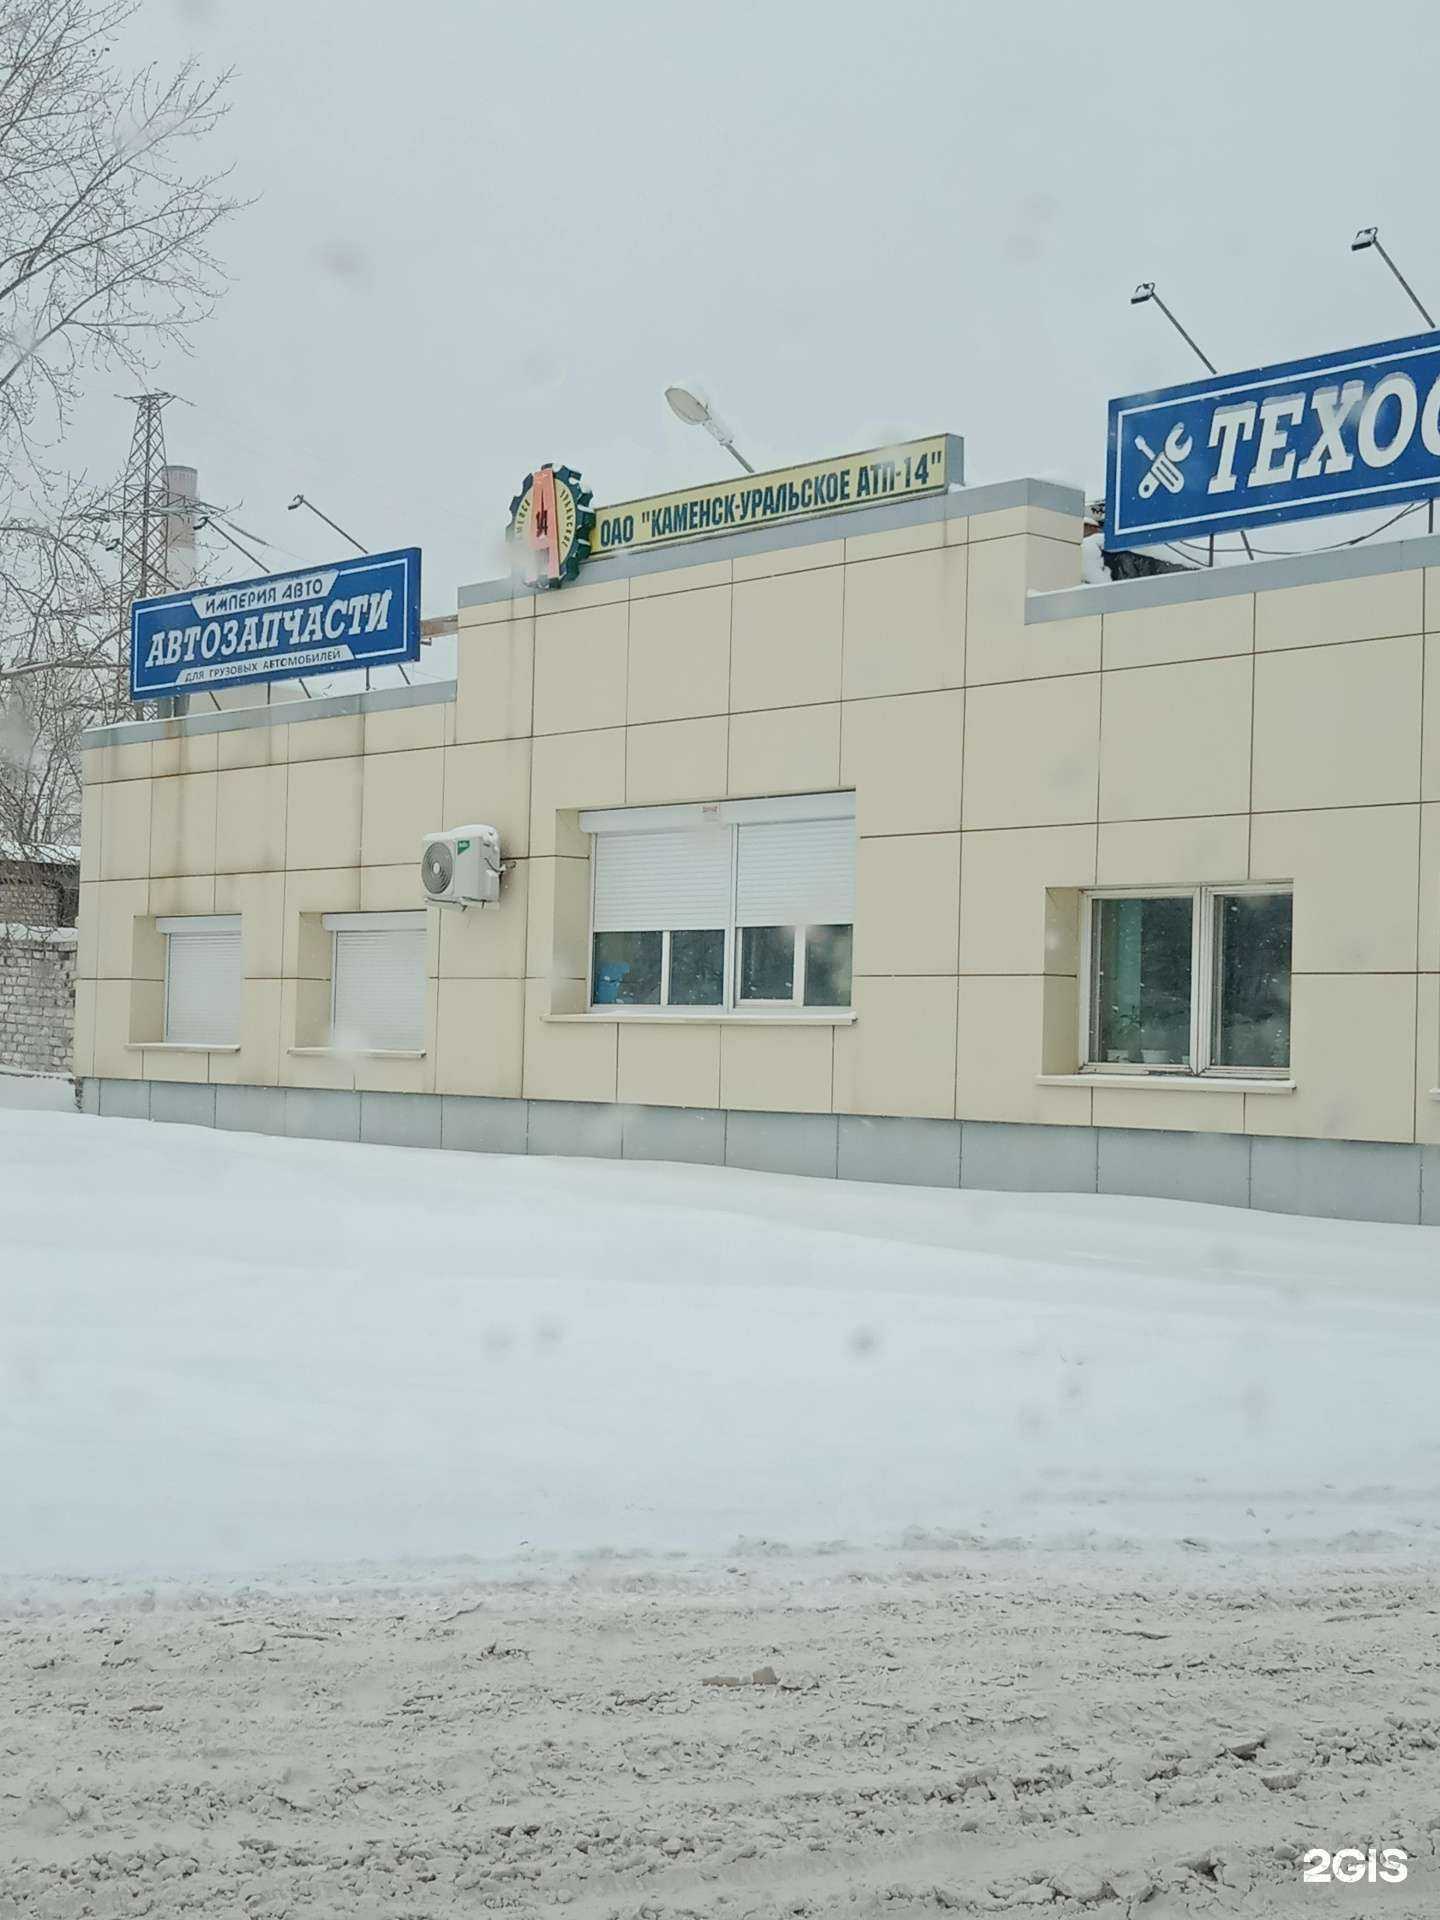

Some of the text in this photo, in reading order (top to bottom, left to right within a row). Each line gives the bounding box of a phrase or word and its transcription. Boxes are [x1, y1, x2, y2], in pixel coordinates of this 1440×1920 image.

[600, 514, 634, 547] ОАО
[642, 469, 851, 537] "КАМЕНСК-УРАЛЬСКОЕ
[856, 451, 943, 496] АТП-14"
[205, 578, 323, 614] ИМПЕРИЯ АВТО
[145, 589, 393, 667] АВТОЗАПЧАСТИ
[185, 649, 341, 682] ДЛЯ ГРУЗОВЫХ АВТОМОБИЛЕЙ
